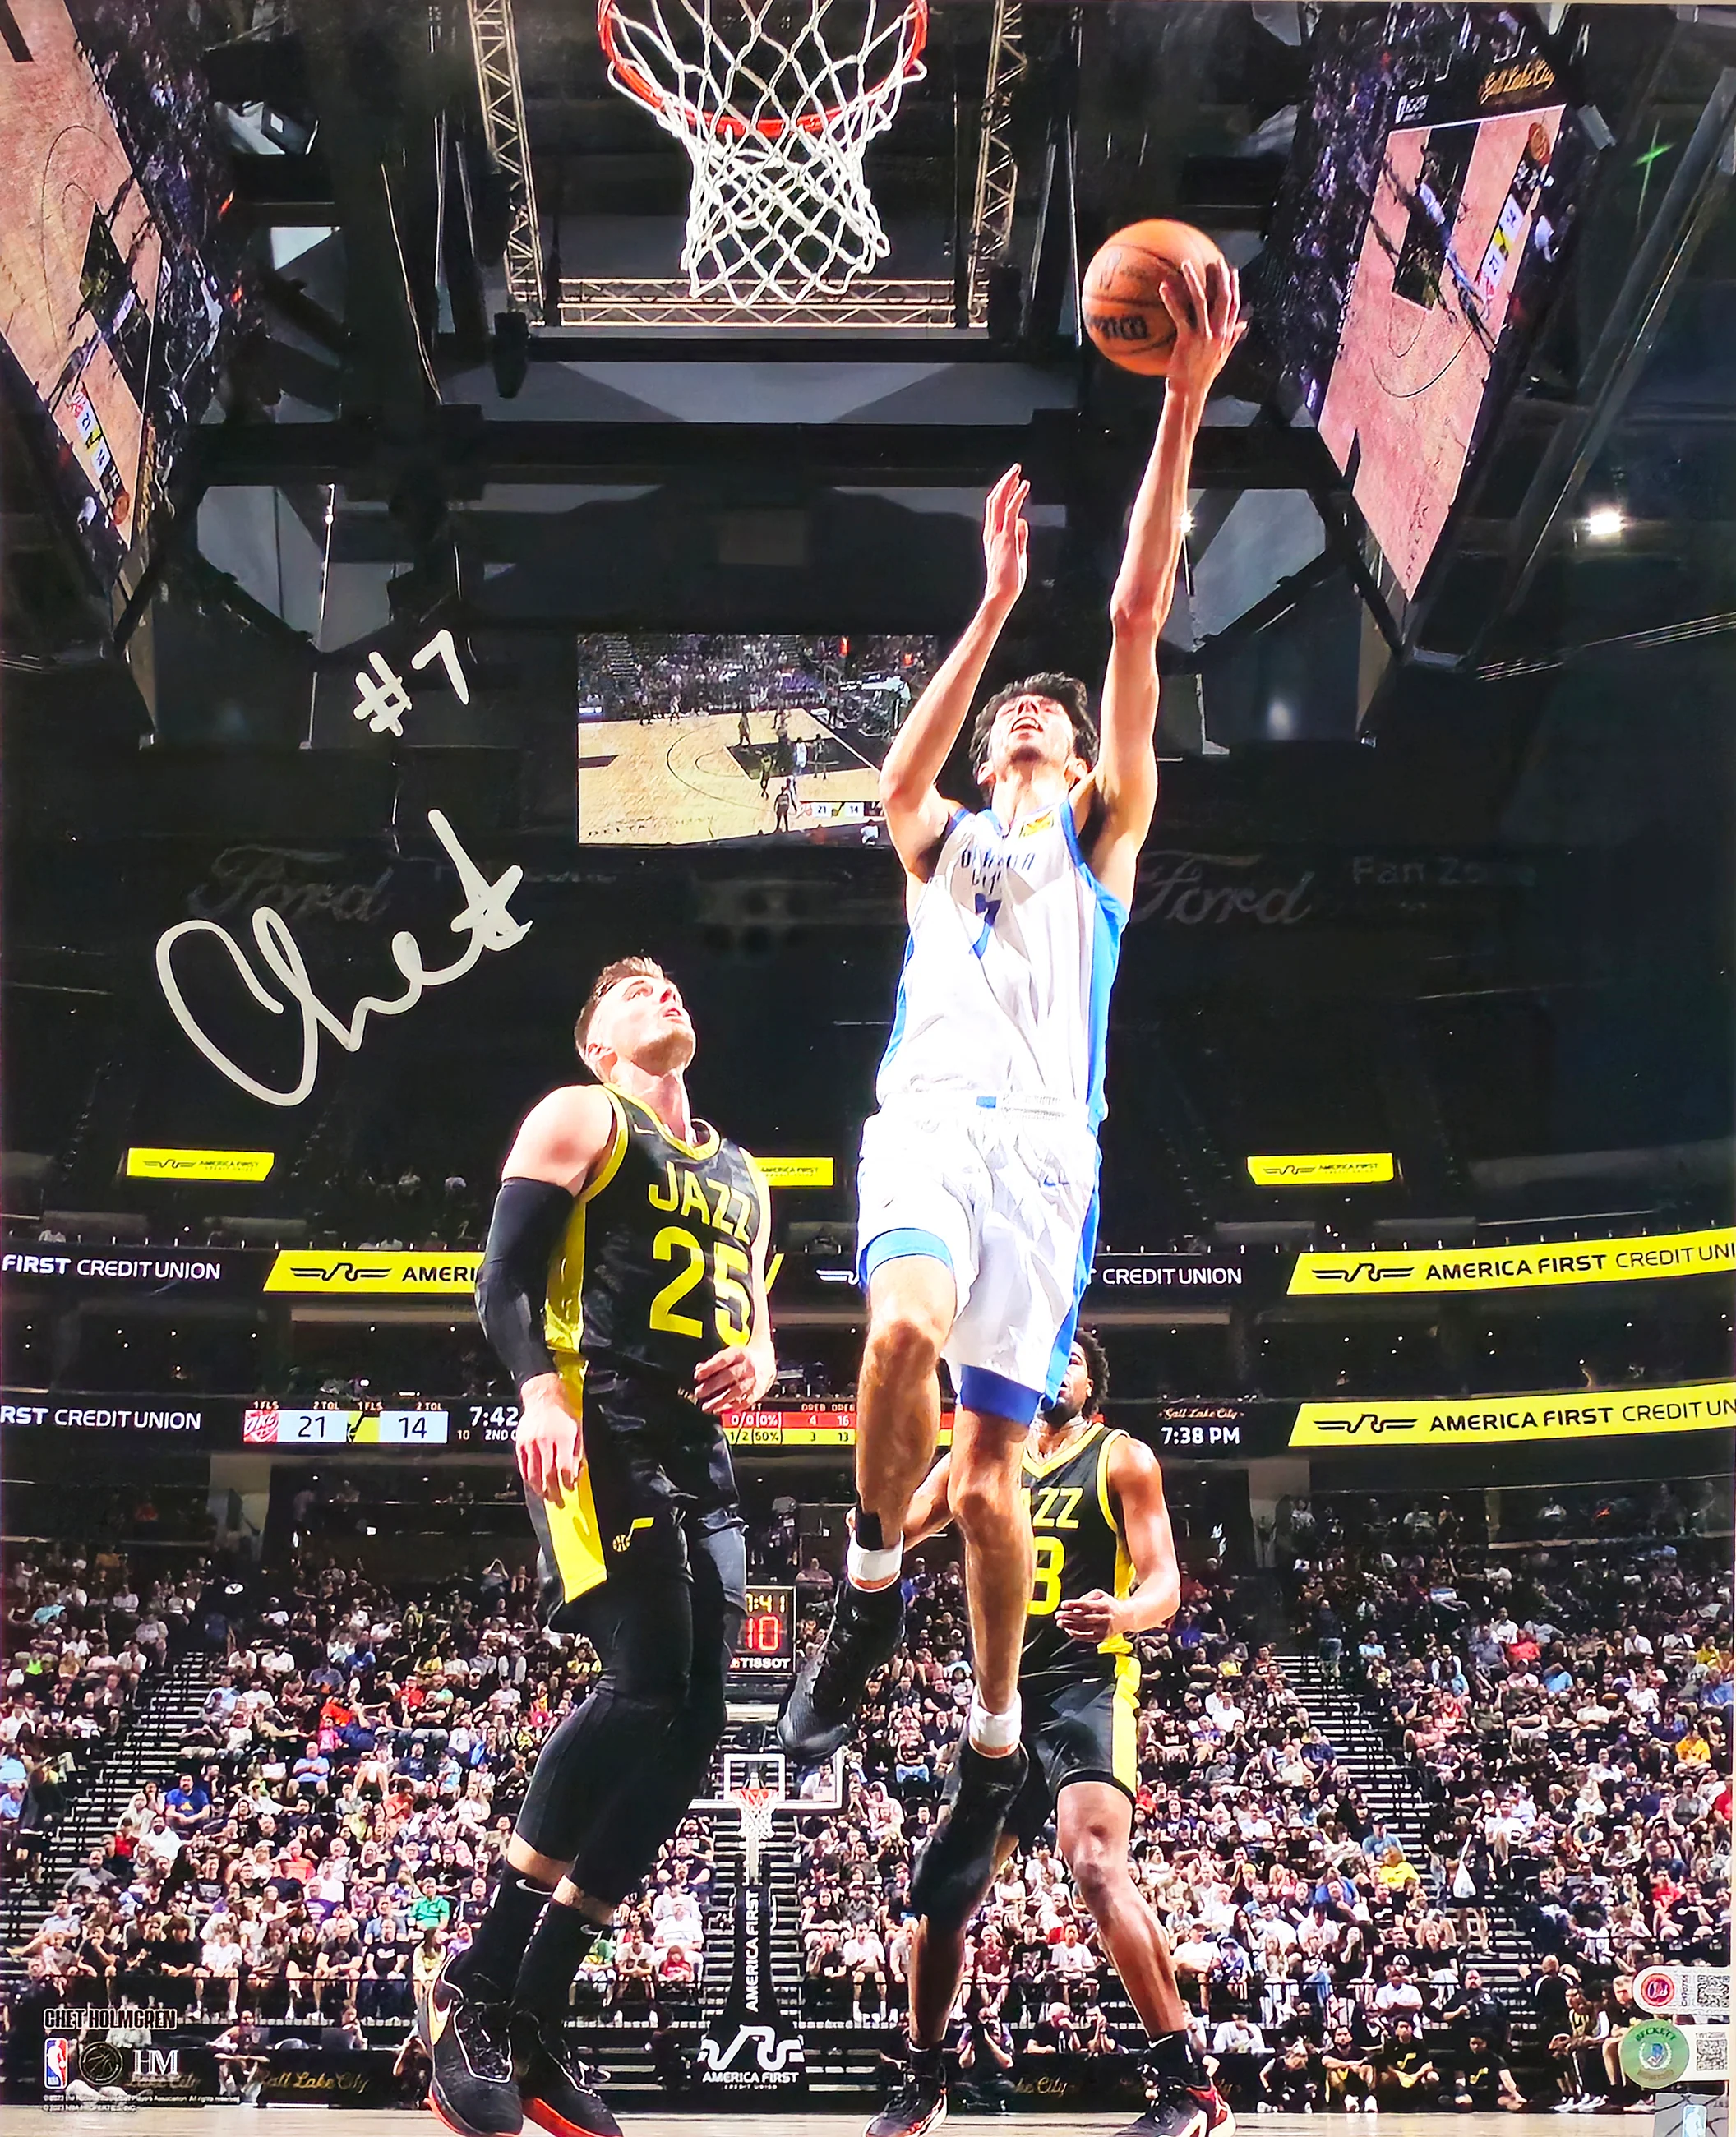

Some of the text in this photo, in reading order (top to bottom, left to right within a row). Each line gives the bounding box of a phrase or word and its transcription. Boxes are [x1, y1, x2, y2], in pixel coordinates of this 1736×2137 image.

[1131, 850, 1315, 925] Ford
[648, 1161, 752, 1244] JAZZ
[2, 1254, 221, 1280] FIRST CREDIT UNION
[1425, 1259, 1533, 1281] AMERICA
[1538, 1254, 1608, 1274] FIRST
[1615, 1247, 1694, 1270] CREDIT
[649, 1225, 751, 1348] 25
[1102, 1268, 1176, 1285] CREDIT
[1178, 1267, 1243, 1285] UNION
[54, 1409, 132, 1428] CREDIT
[134, 1411, 201, 1429] UNION
[298, 1415, 326, 1438] 21
[469, 1405, 519, 1427] 7:42
[809, 1415, 818, 1426] 4
[837, 1415, 850, 1426] 16
[1429, 1411, 1537, 1433] AMERICA
[1544, 1407, 1614, 1427] FIRST
[1623, 1401, 1703, 1422] CREDIT
[398, 1416, 427, 1439] 14
[457, 1429, 470, 1441] 10
[484, 1429, 509, 1441] 2ND
[838, 1432, 849, 1442] 13
[1161, 1427, 1240, 1445] 7:38 PM
[747, 1616, 779, 1651] 10
[740, 1657, 791, 1669] TISSOT
[745, 1889, 760, 2013] AMERICA FIRST
[293, 2072, 334, 2089] Lake
[336, 2072, 369, 2094] City
[702, 2071, 800, 2083] AMERICA FIRST
